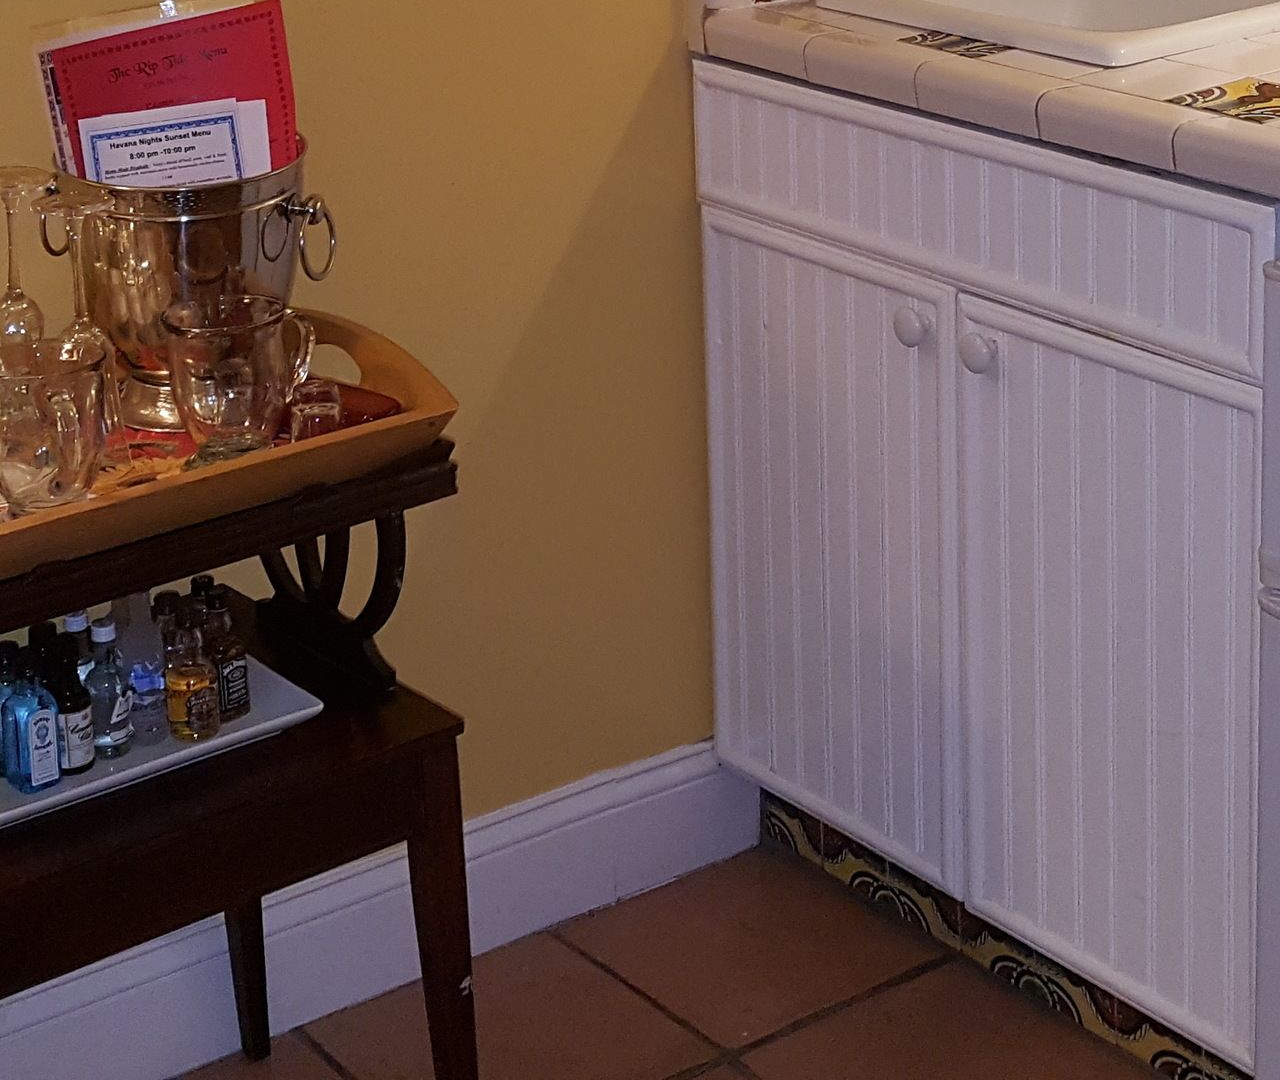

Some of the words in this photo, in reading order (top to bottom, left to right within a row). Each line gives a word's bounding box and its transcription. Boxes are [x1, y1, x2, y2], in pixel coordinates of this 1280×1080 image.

[133, 60, 158, 76] Rip
[109, 139, 137, 150] Havana
[138, 136, 162, 147] Nights
[164, 131, 190, 142] Sunset
[191, 129, 211, 138] Menu
[129, 150, 145, 160] 8:00
[146, 150, 159, 159] pm
[184, 145, 196, 153] pm
